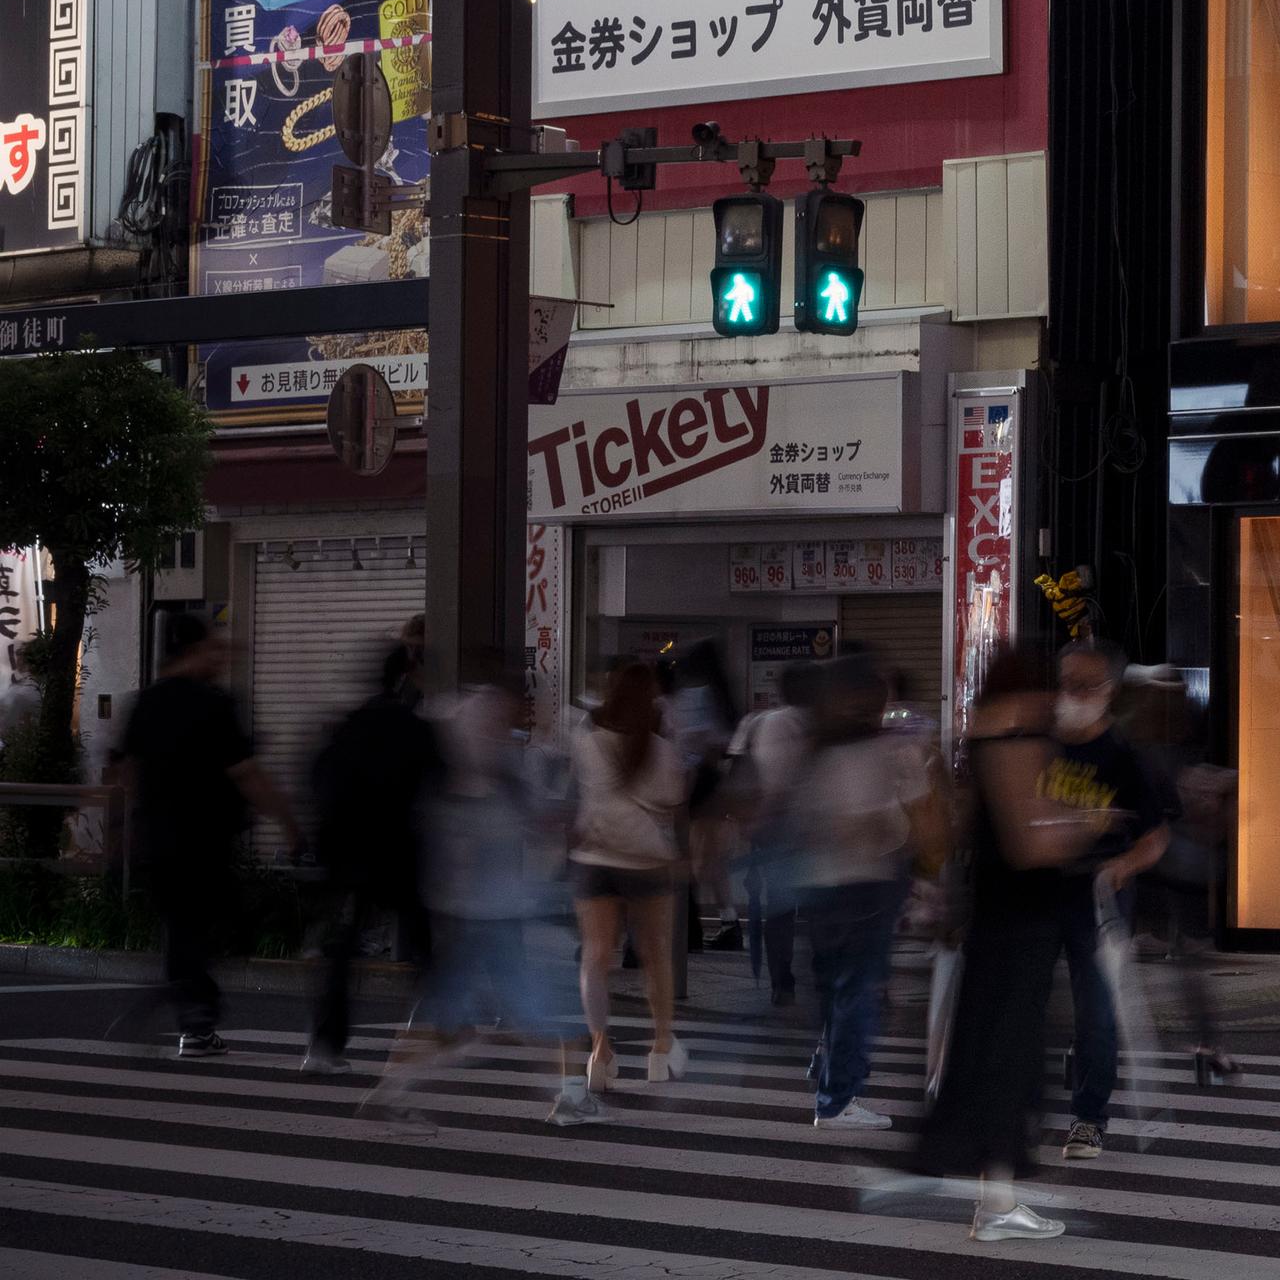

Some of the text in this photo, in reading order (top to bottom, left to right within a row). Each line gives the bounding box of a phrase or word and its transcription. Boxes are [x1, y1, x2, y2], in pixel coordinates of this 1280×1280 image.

[213, 211, 295, 241] 正確な査定
[260, 366, 346, 394] お見積り無
[528, 385, 770, 510] Tickety
[769, 439, 862, 464] 金券ショップ
[769, 471, 831, 495] 外貨両替
